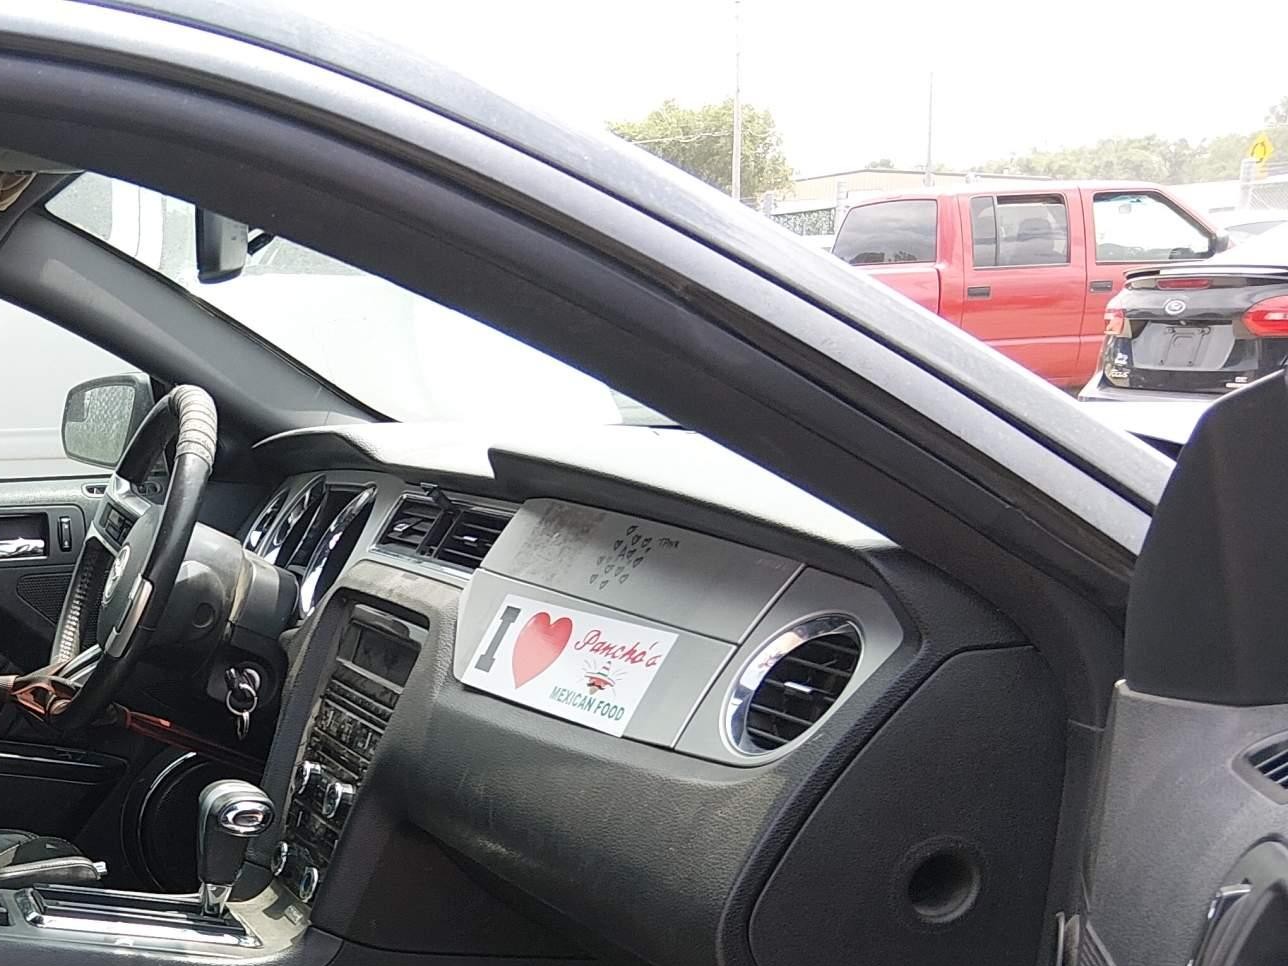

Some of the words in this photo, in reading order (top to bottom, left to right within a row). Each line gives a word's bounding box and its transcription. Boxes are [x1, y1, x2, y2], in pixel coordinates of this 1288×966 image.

[475, 605, 521, 673] I
[574, 629, 662, 667] Pancho's
[550, 685, 596, 712] MEXICAN
[594, 700, 625, 721] FOOD
